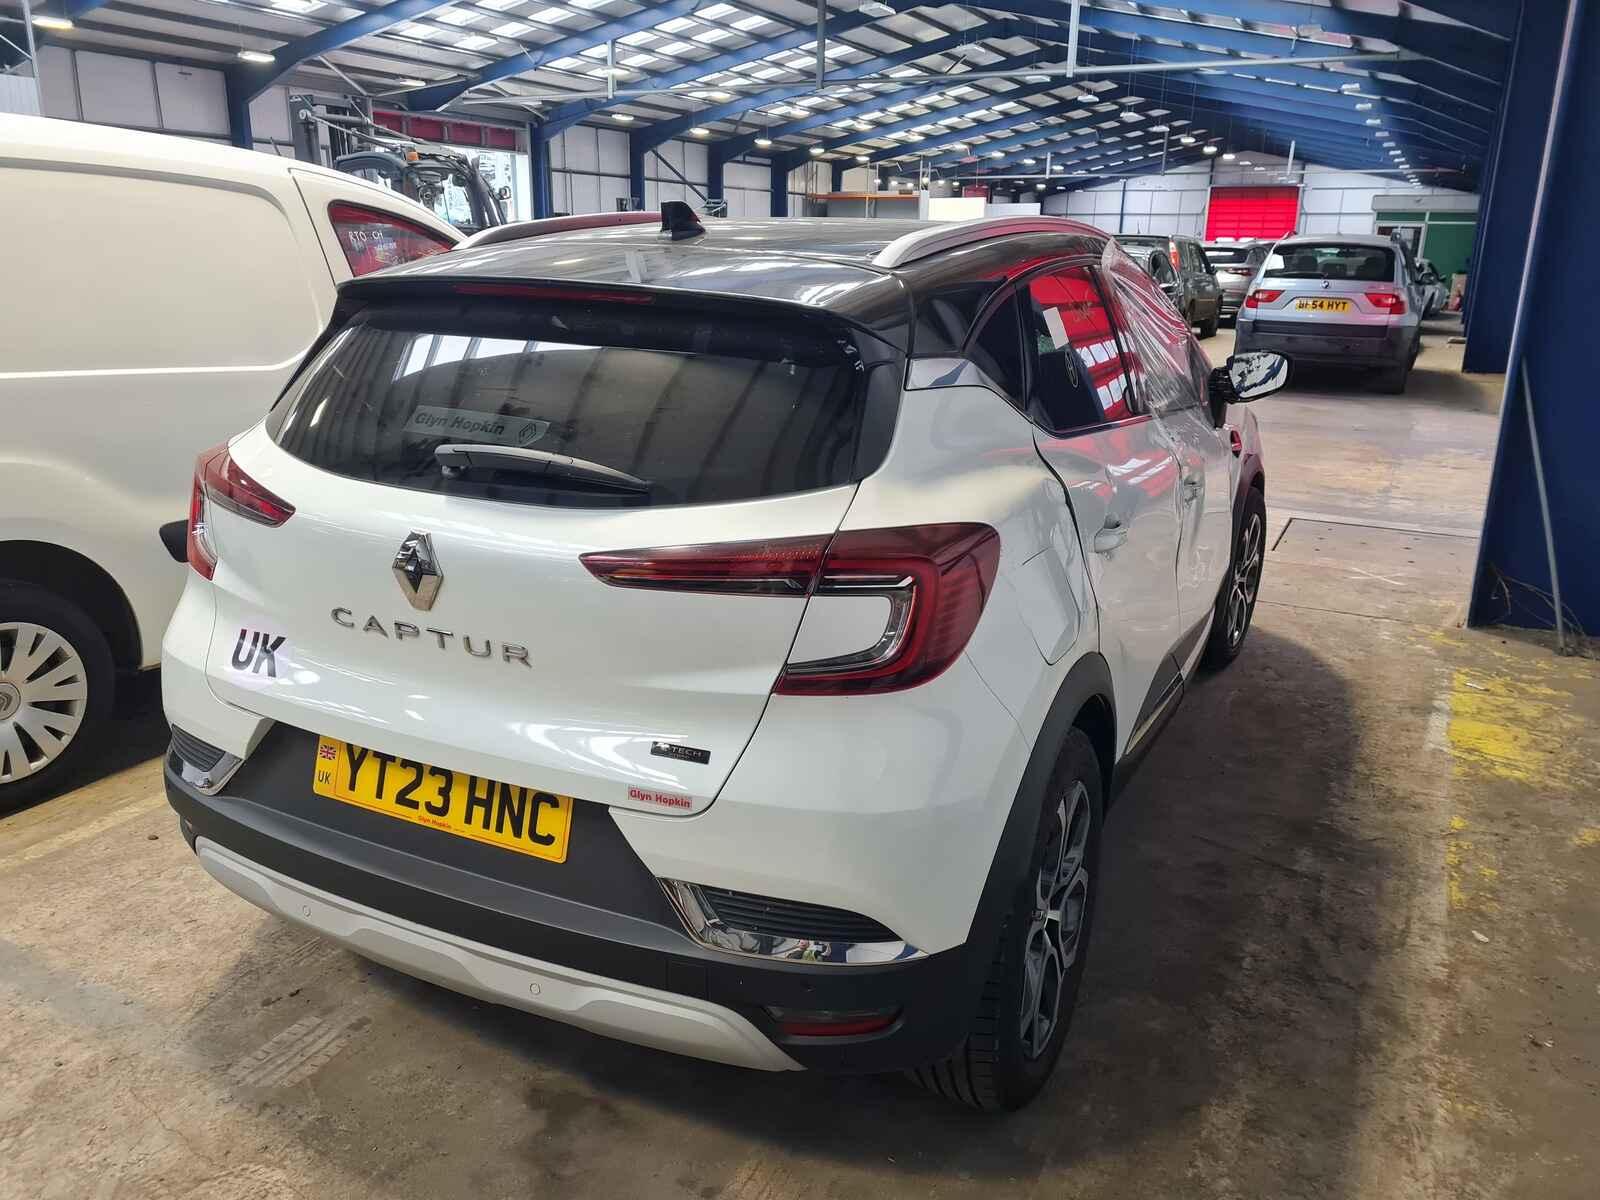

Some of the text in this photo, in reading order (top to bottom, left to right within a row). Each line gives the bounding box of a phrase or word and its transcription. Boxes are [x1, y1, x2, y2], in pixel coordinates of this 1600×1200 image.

[1327, 301, 1348, 311] HYT
[415, 412, 505, 435] Glyn Hopkin
[330, 607, 533, 669] CAPTUR
[231, 628, 286, 678] UK
[317, 770, 331, 785] UK
[346, 742, 560, 846] YT23 HNC
[630, 789, 690, 808] Glyn Hopkin
